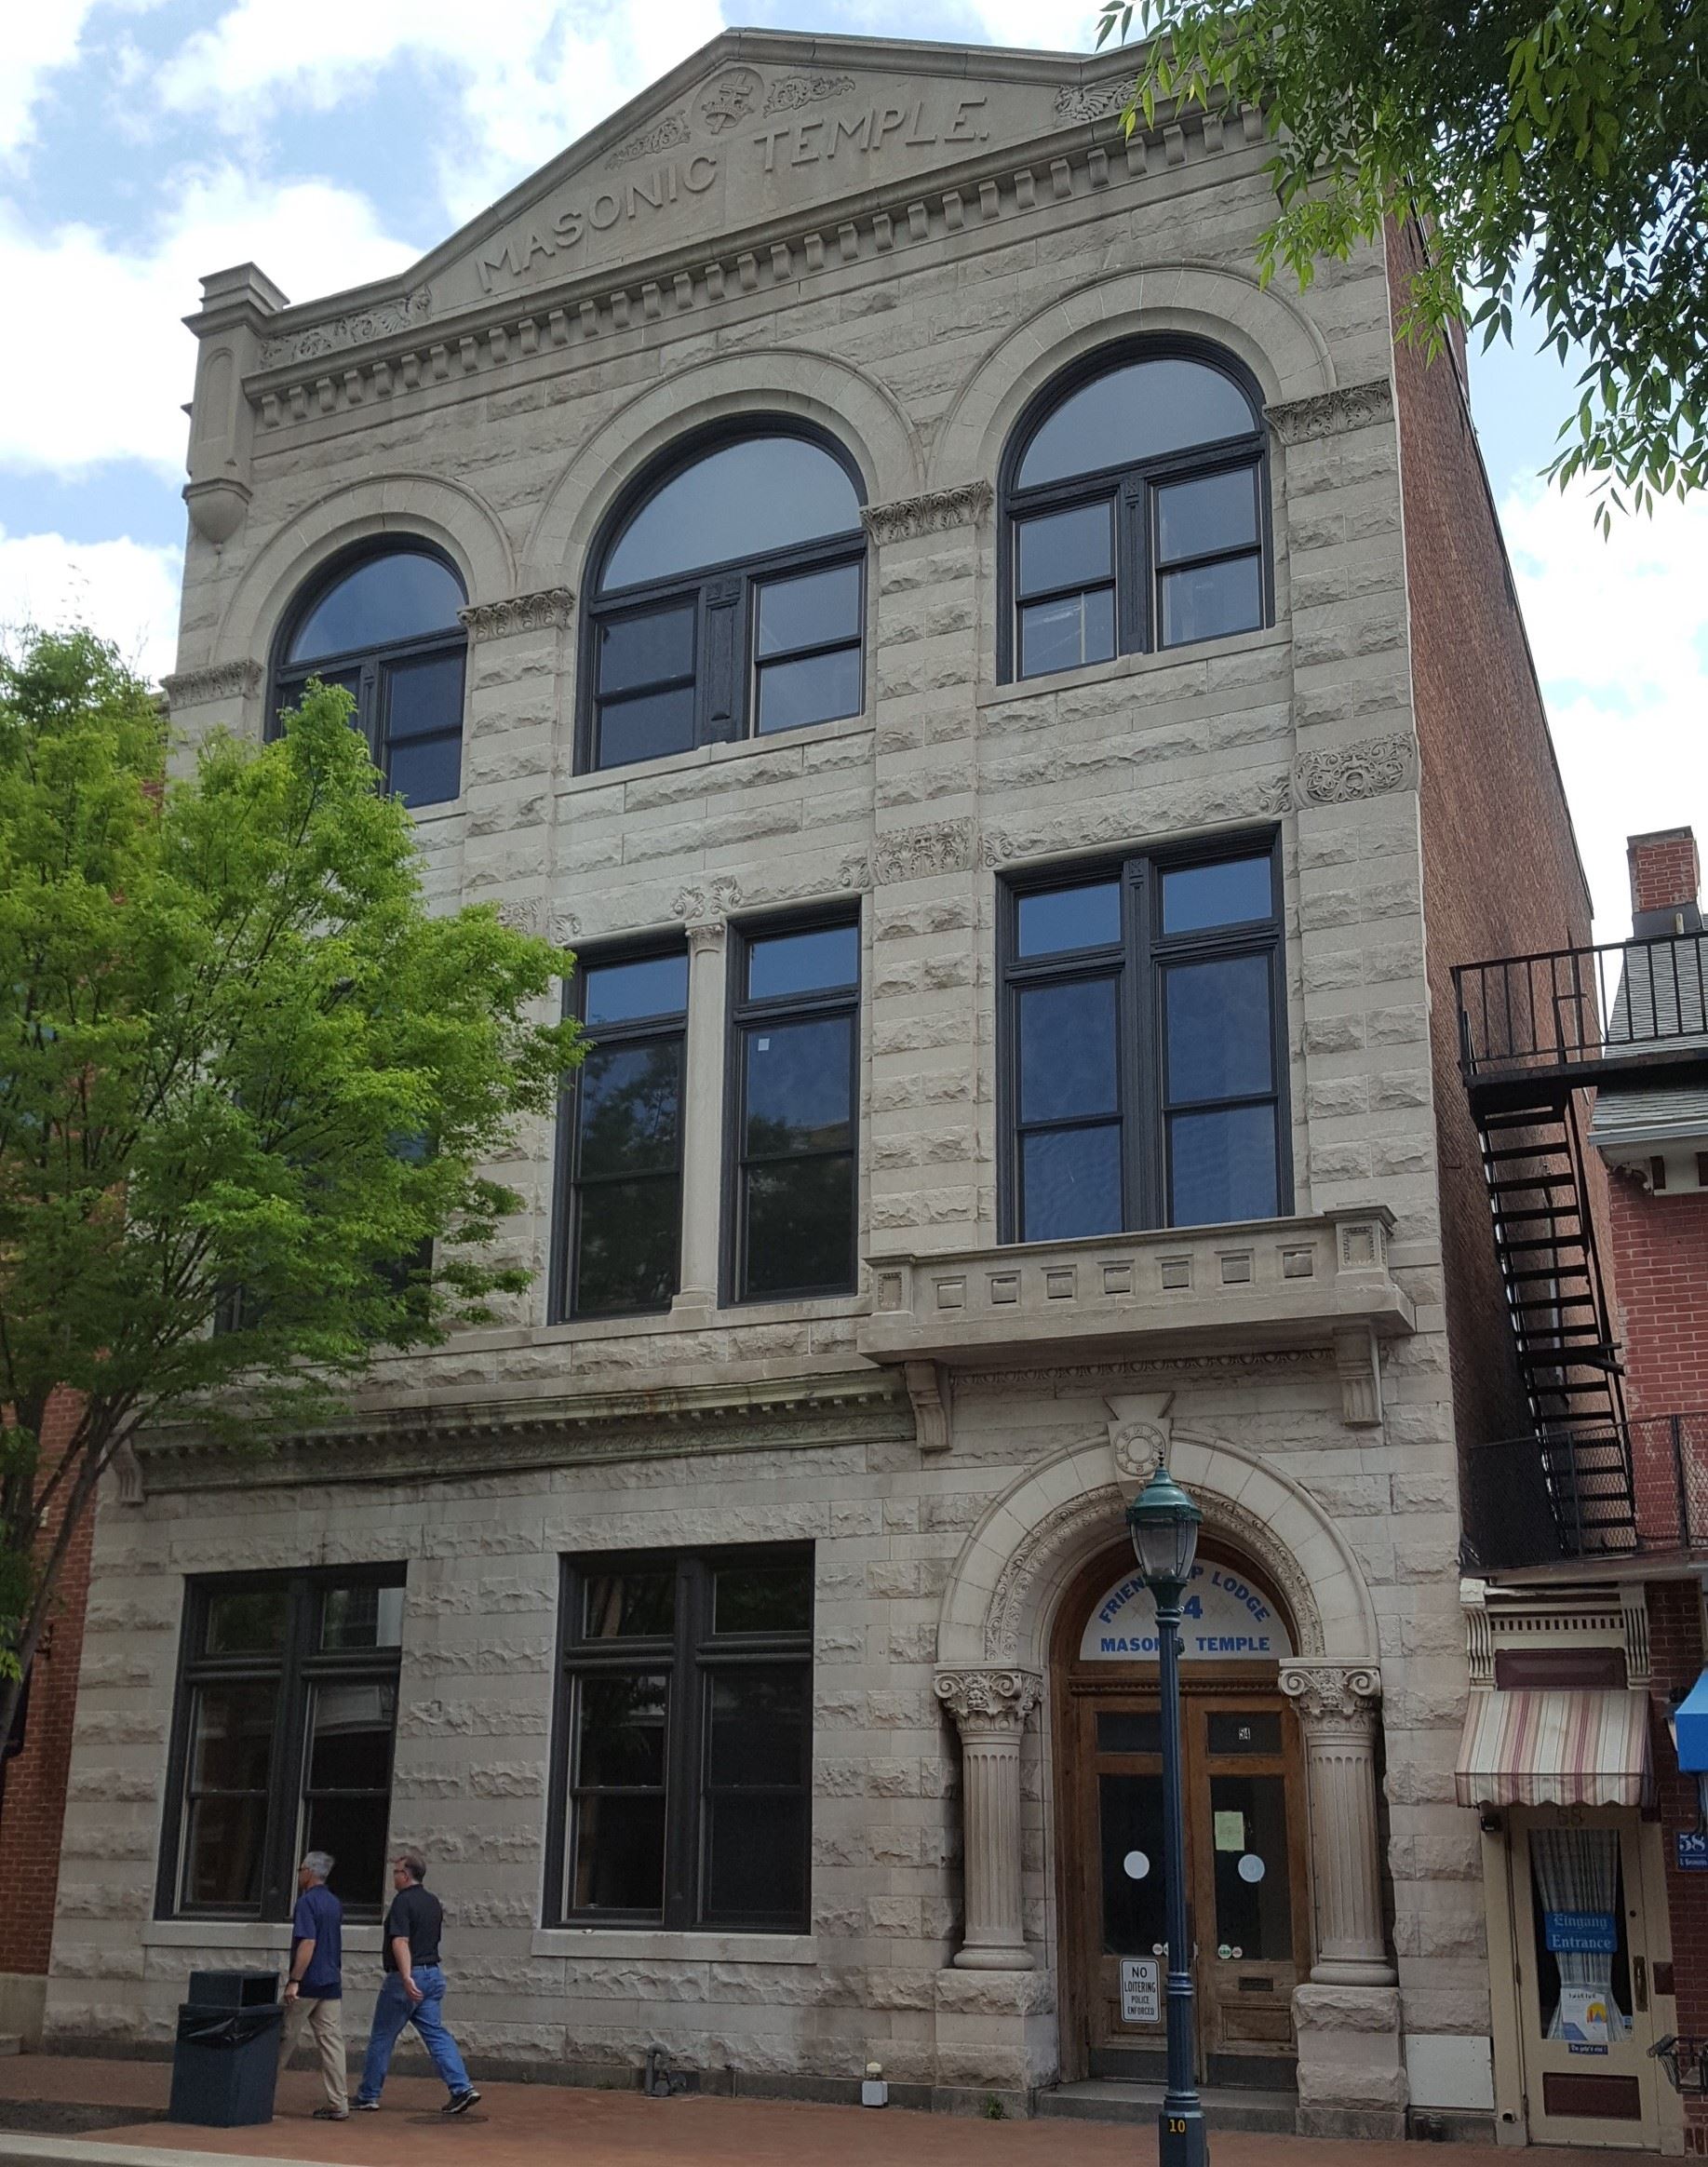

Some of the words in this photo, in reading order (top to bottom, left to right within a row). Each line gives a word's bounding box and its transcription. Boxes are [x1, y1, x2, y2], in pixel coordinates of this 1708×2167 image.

[476, 156, 717, 293] MASONIC
[1099, 1566, 1204, 1623] FRIENP
[1212, 1570, 1271, 1622] LODGE
[1184, 1595, 1203, 1619] 4
[1195, 1636, 1271, 1651] TEMPLE
[1679, 1834, 1706, 1851] 58
[1553, 1913, 1608, 1930] Eingang
[1552, 1934, 1611, 1949] Entrance
[1132, 1966, 1148, 1978] NO
[1124, 1981, 1156, 1993] LOITERING
[1131, 1995, 1150, 2004] POLICE
[1127, 2006, 1155, 2016] ENFORCED
[1169, 2119, 1186, 2133] 10
